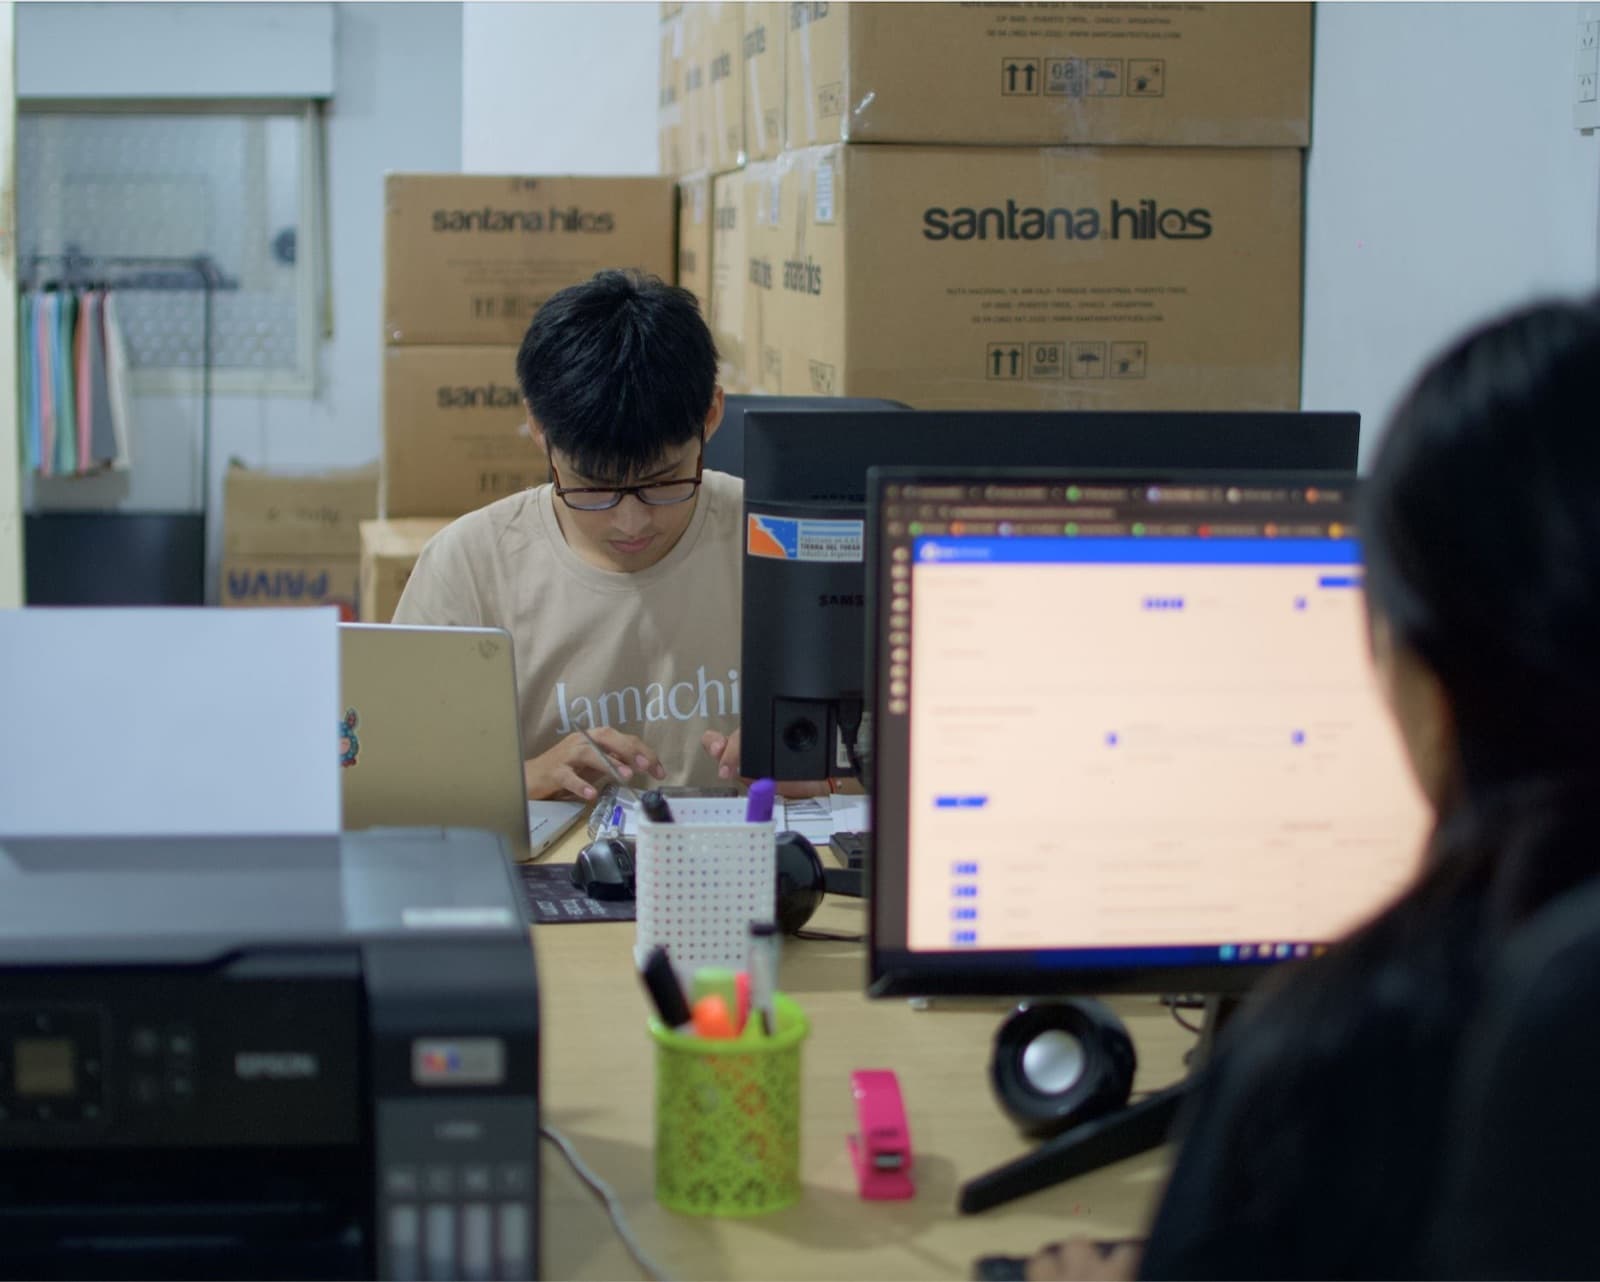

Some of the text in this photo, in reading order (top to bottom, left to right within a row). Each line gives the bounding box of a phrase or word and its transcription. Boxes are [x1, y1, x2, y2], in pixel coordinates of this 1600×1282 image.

[432, 204, 615, 234] santana hilos
[922, 198, 1213, 241] santana hilos
[1035, 346, 1058, 364] 08
[437, 382, 519, 408] santa
[818, 594, 864, 607] SAMS
